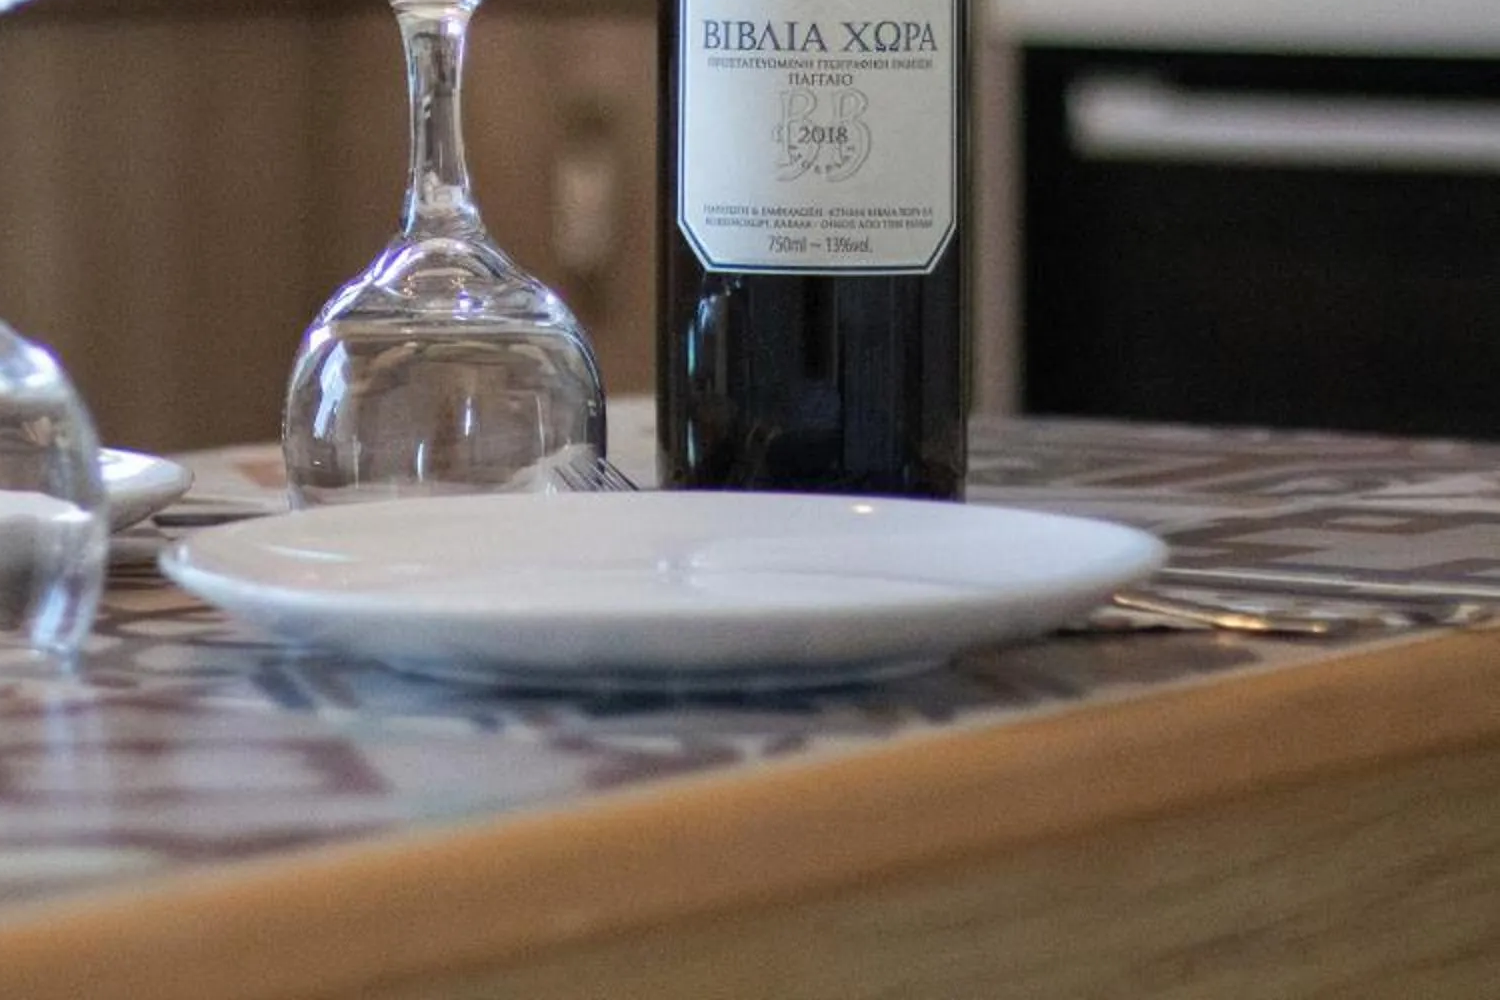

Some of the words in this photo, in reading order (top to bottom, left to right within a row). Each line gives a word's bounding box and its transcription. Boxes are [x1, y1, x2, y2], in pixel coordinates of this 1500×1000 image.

[703, 19, 828, 51] ΒΙΒΛΙΑ
[840, 21, 938, 53] ΧΩΡΑ
[797, 125, 849, 144] 2018
[768, 235, 807, 253] 750ml
